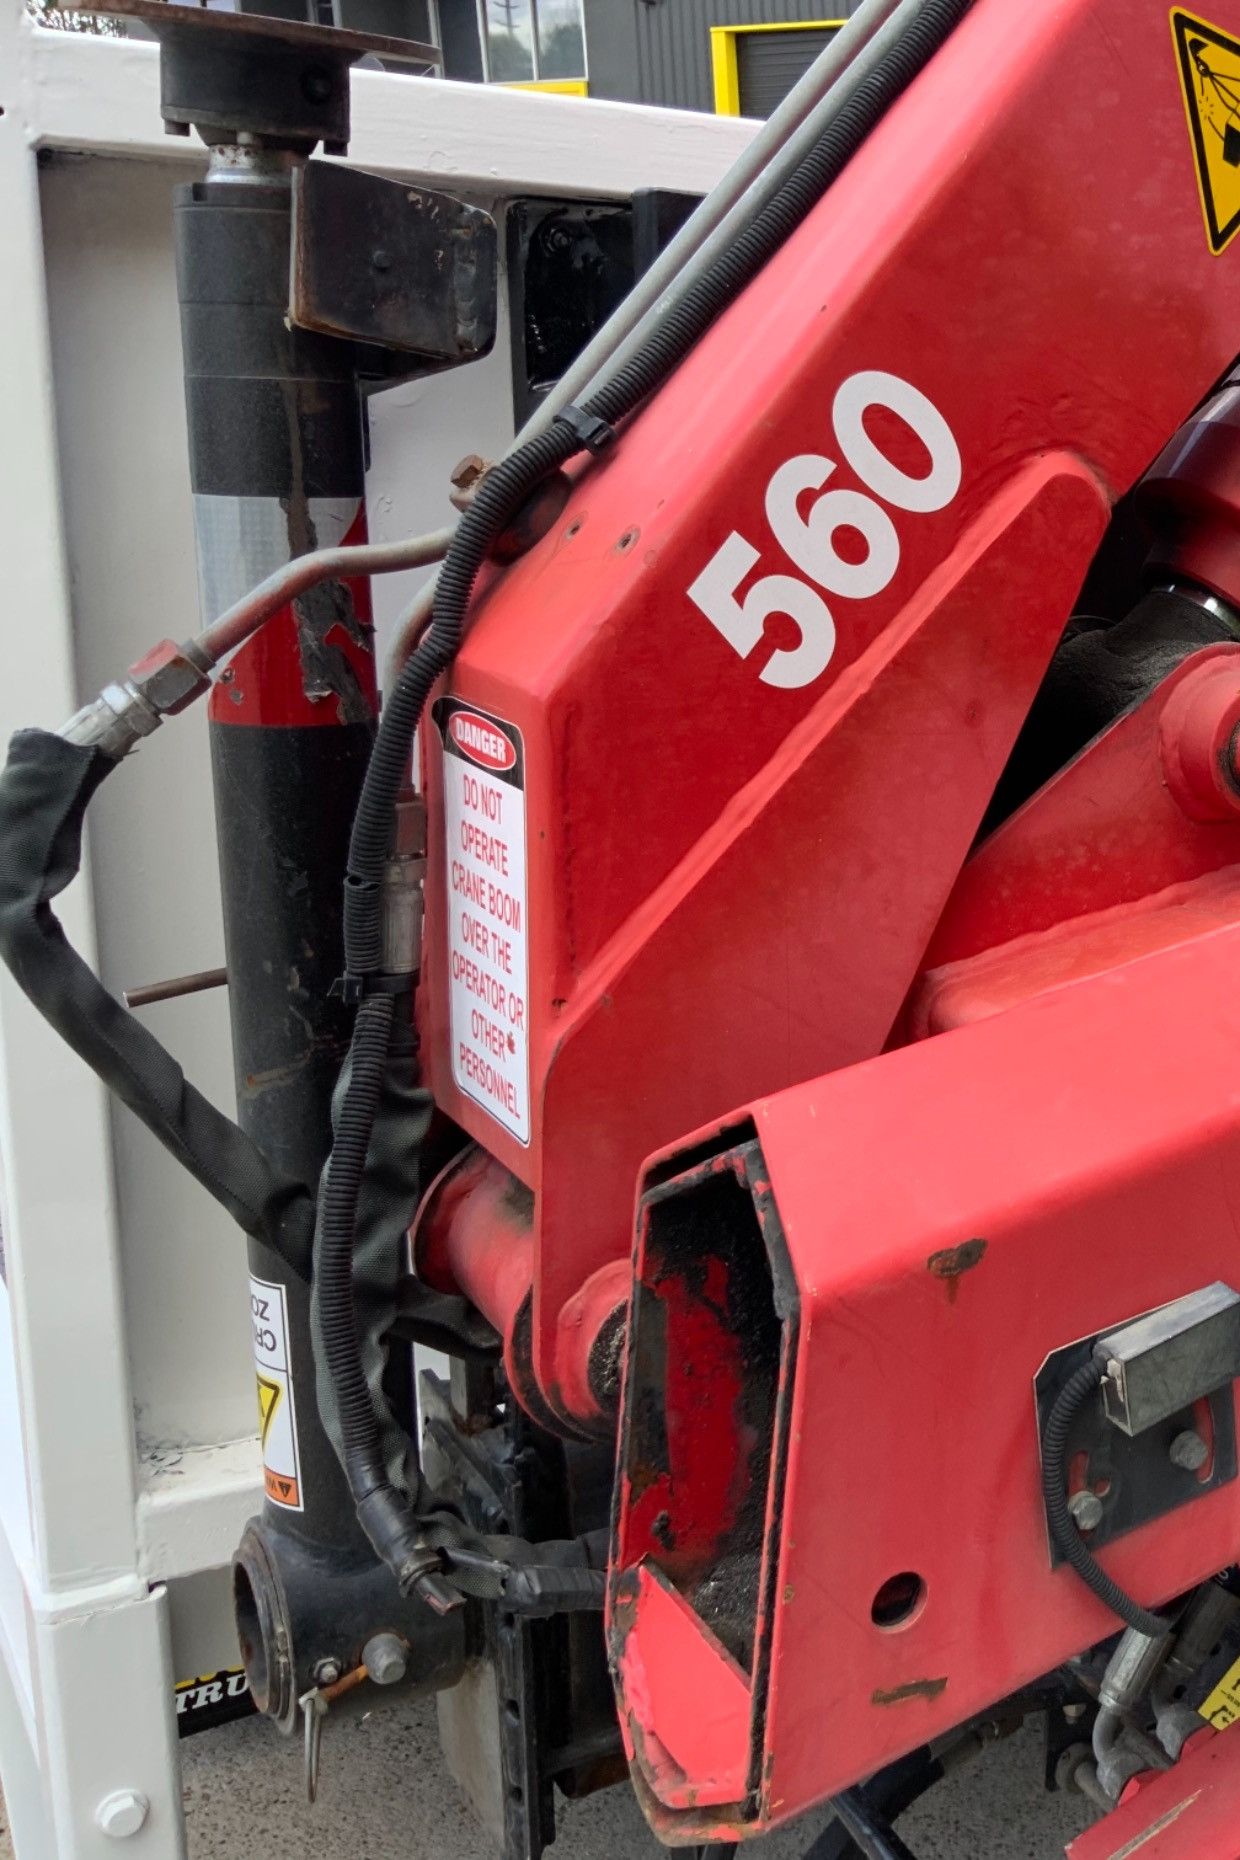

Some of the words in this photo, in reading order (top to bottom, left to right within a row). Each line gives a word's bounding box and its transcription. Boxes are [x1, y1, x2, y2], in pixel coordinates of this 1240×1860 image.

[686, 370, 962, 690] 560
[455, 717, 507, 763] DANGER
[463, 774, 479, 811] DO
[481, 783, 502, 825] NOT
[460, 819, 509, 877] OPERATE
[452, 860, 486, 909] CRANE
[488, 883, 521, 933] BOOM
[461, 912, 489, 958] OVER
[491, 931, 512, 975] THE
[452, 950, 507, 1018] OPERATOR
[508, 992, 524, 1031] OR
[471, 1009, 506, 1063] OTHER
[459, 1042, 521, 1120] PERSONNEL
